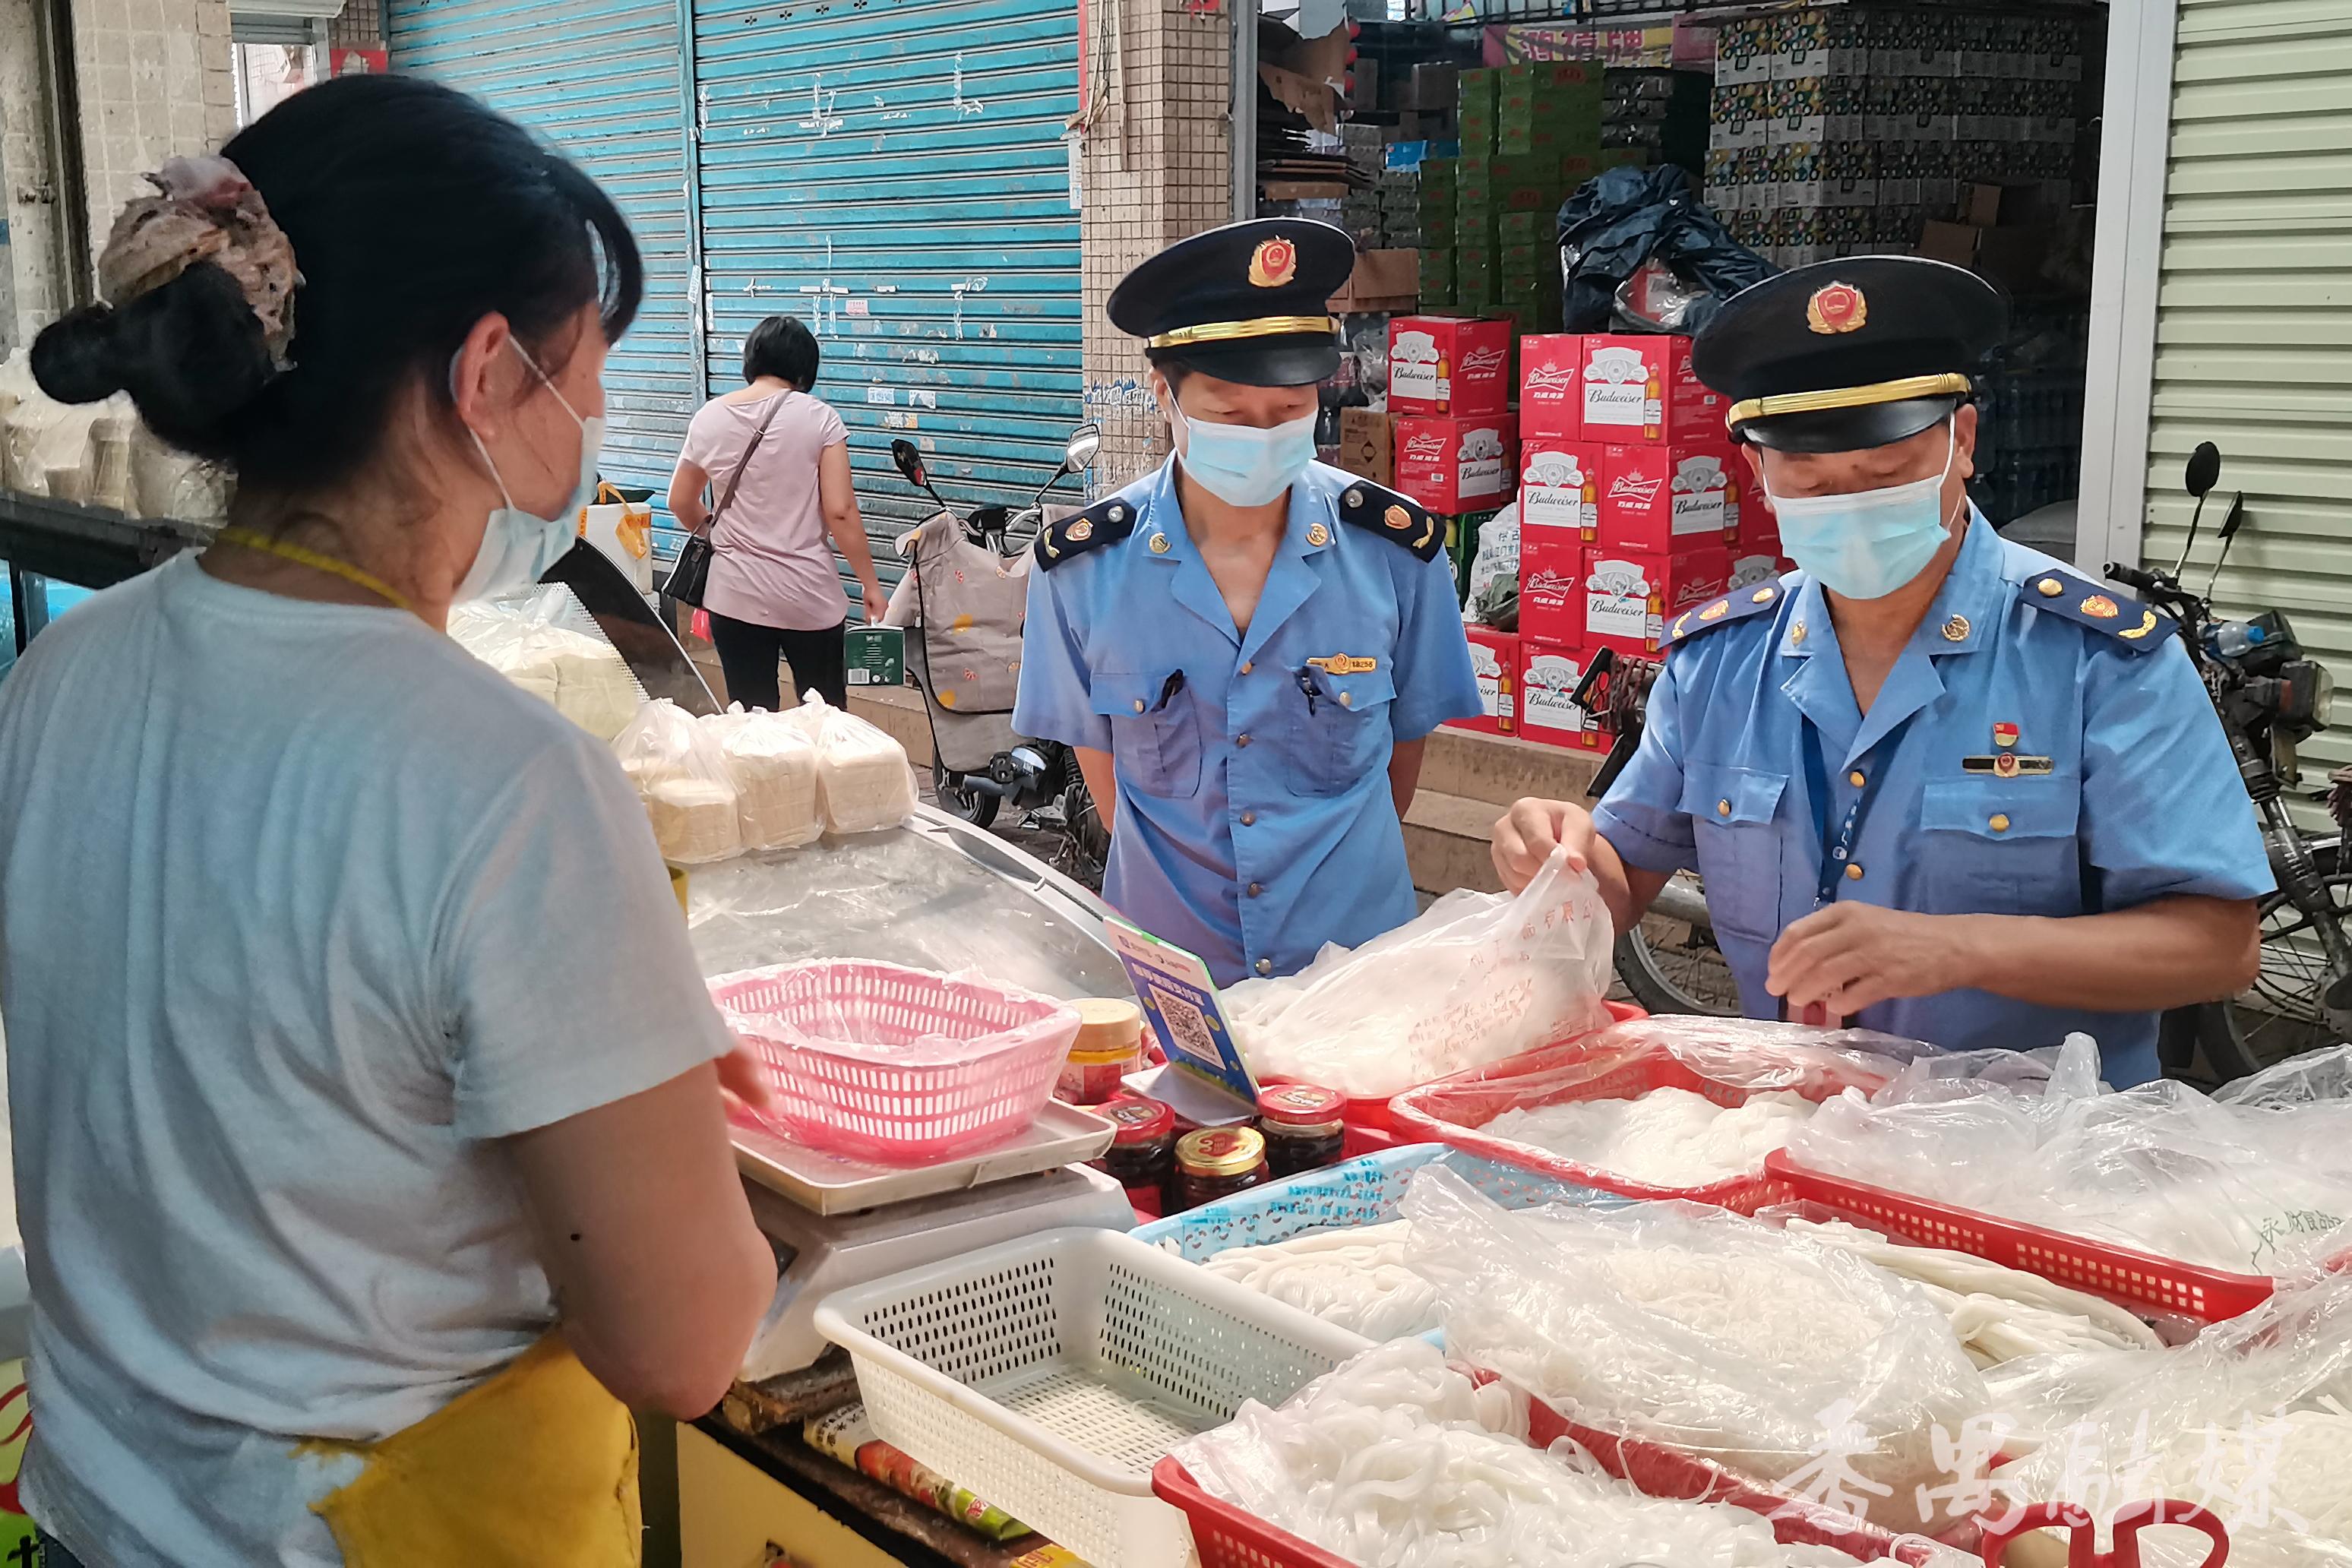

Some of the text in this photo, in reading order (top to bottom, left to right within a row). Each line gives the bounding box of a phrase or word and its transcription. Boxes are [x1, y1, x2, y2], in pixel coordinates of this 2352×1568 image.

[1393, 365, 1434, 381] Budweiser
[1588, 389, 1642, 404] Budweiser
[1460, 465, 1500, 480] Budweiser
[1527, 491, 1579, 507] Budweiser
[1674, 499, 1723, 514] Budweiser
[1590, 599, 1644, 617] Budweiser
[1527, 692, 1580, 710] Budweiser
